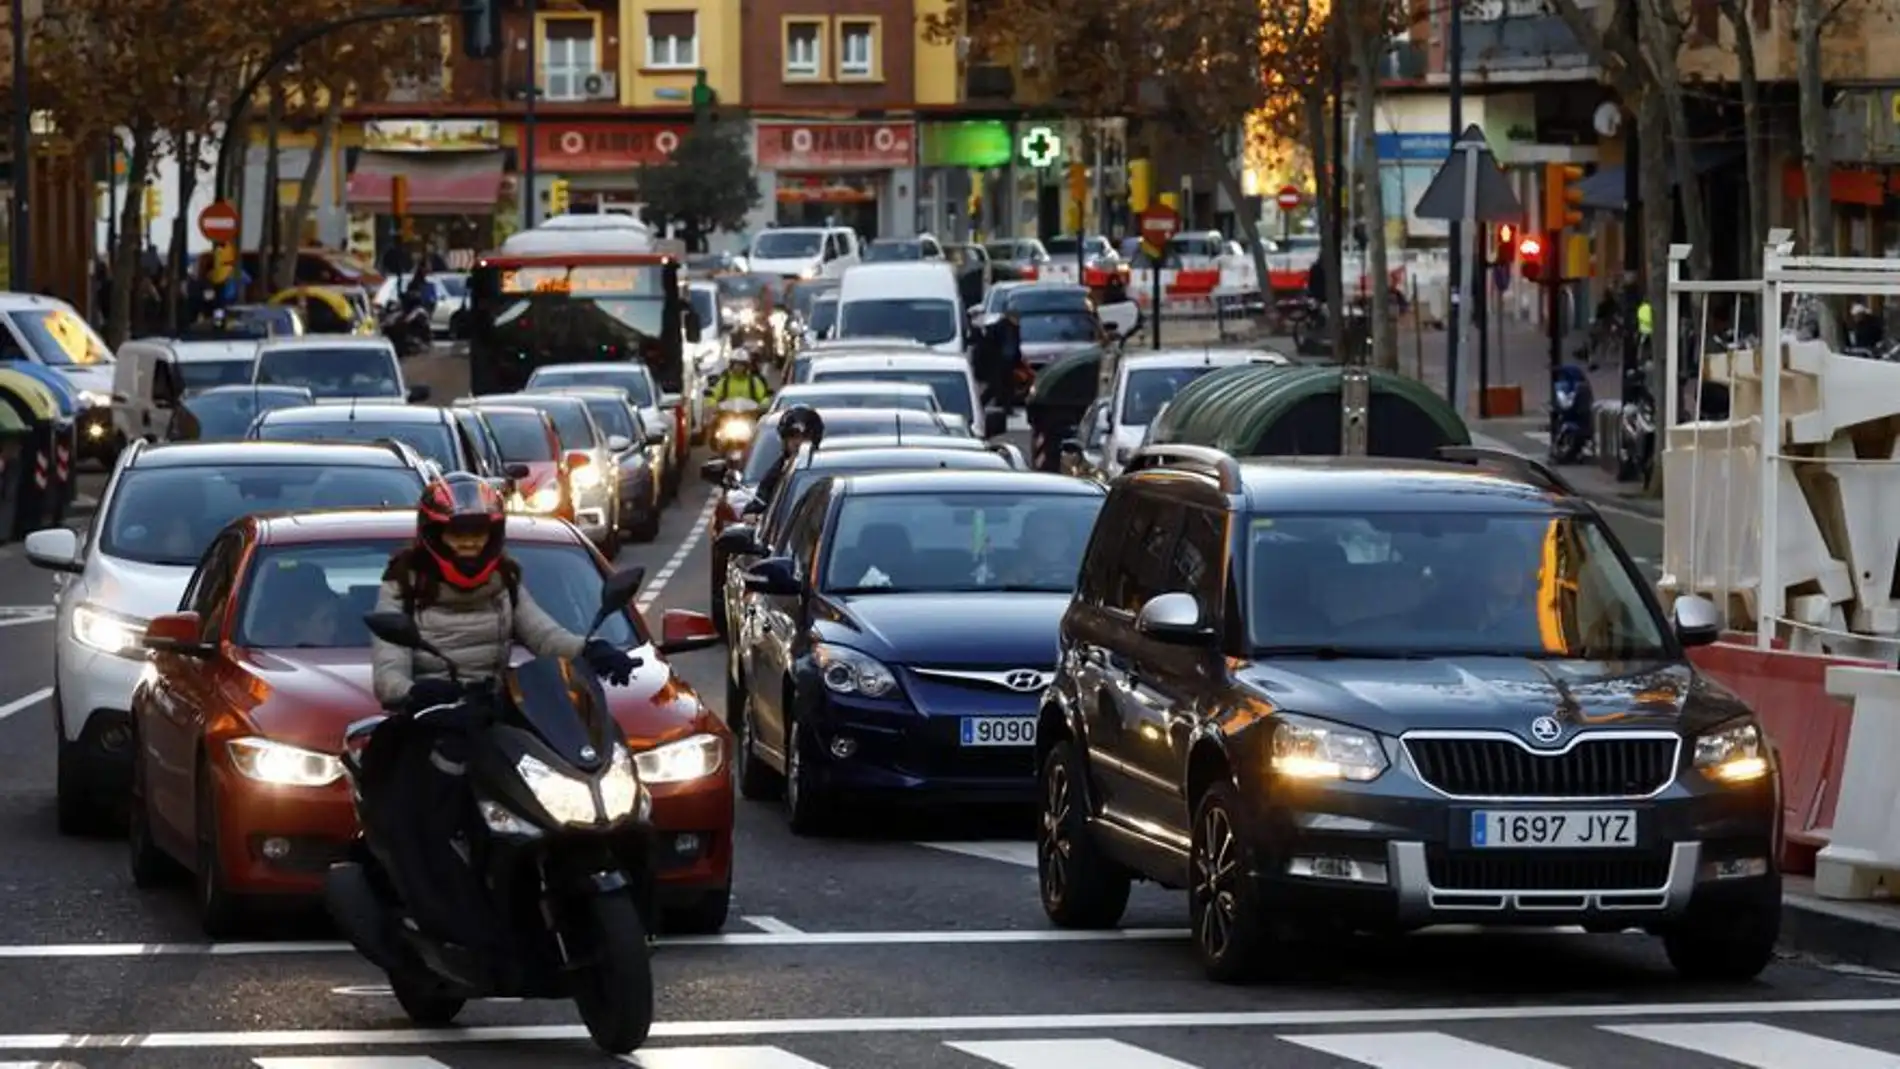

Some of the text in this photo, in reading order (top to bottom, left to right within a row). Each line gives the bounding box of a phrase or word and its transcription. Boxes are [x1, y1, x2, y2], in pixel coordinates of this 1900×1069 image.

[978, 721, 1034, 742] 9090
[1497, 815, 1566, 843] 1697
[1577, 815, 1631, 843] JYZ
